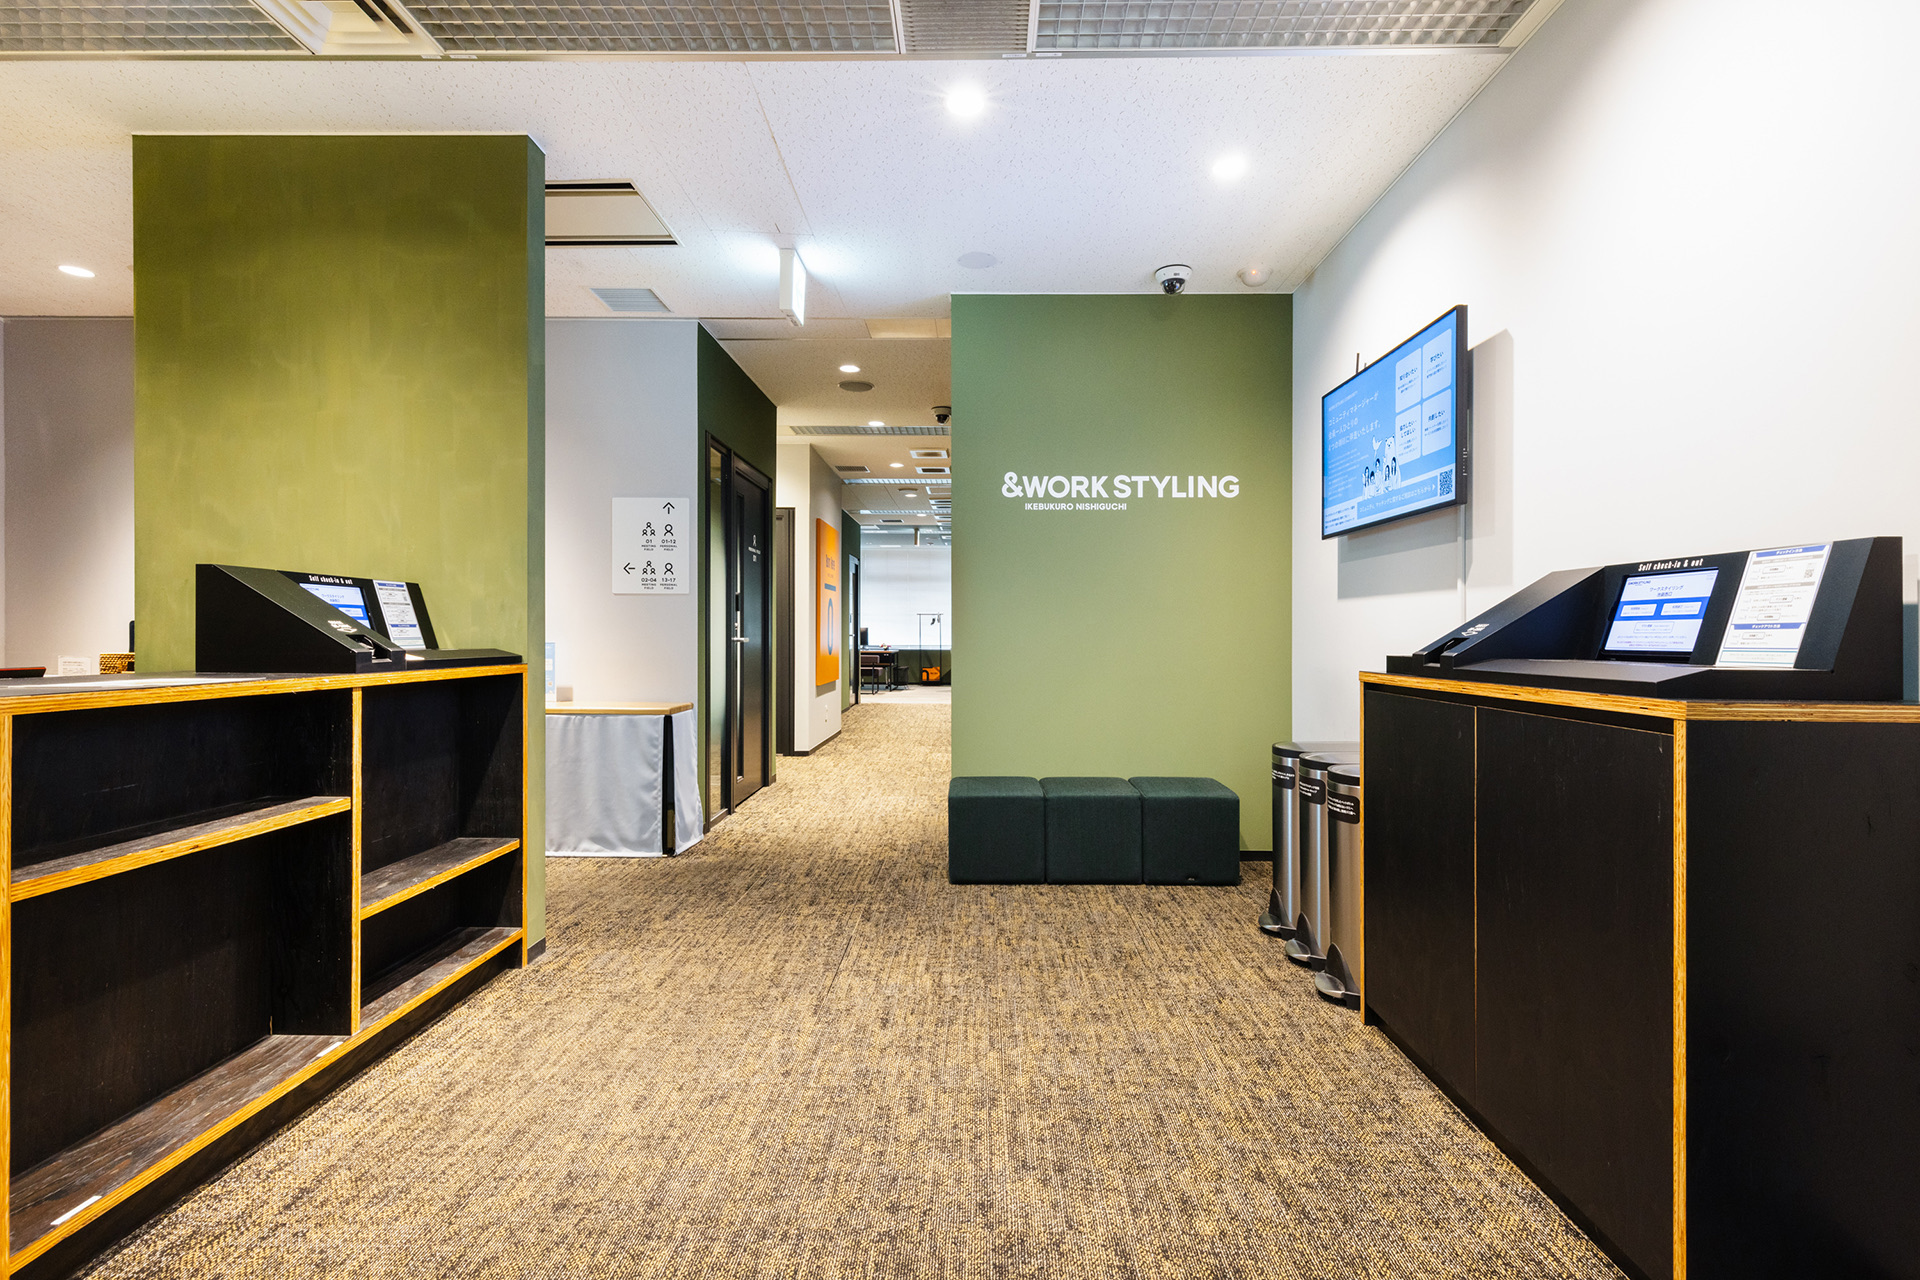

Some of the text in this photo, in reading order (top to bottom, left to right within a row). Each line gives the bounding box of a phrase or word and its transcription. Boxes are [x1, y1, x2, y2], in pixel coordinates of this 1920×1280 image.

[1001, 471, 1240, 498] &WORK STYLING
[1024, 503, 1127, 511] IKEBUKURO NISHIGUCHI
[1638, 558, 1704, 572] Self check-in & out
